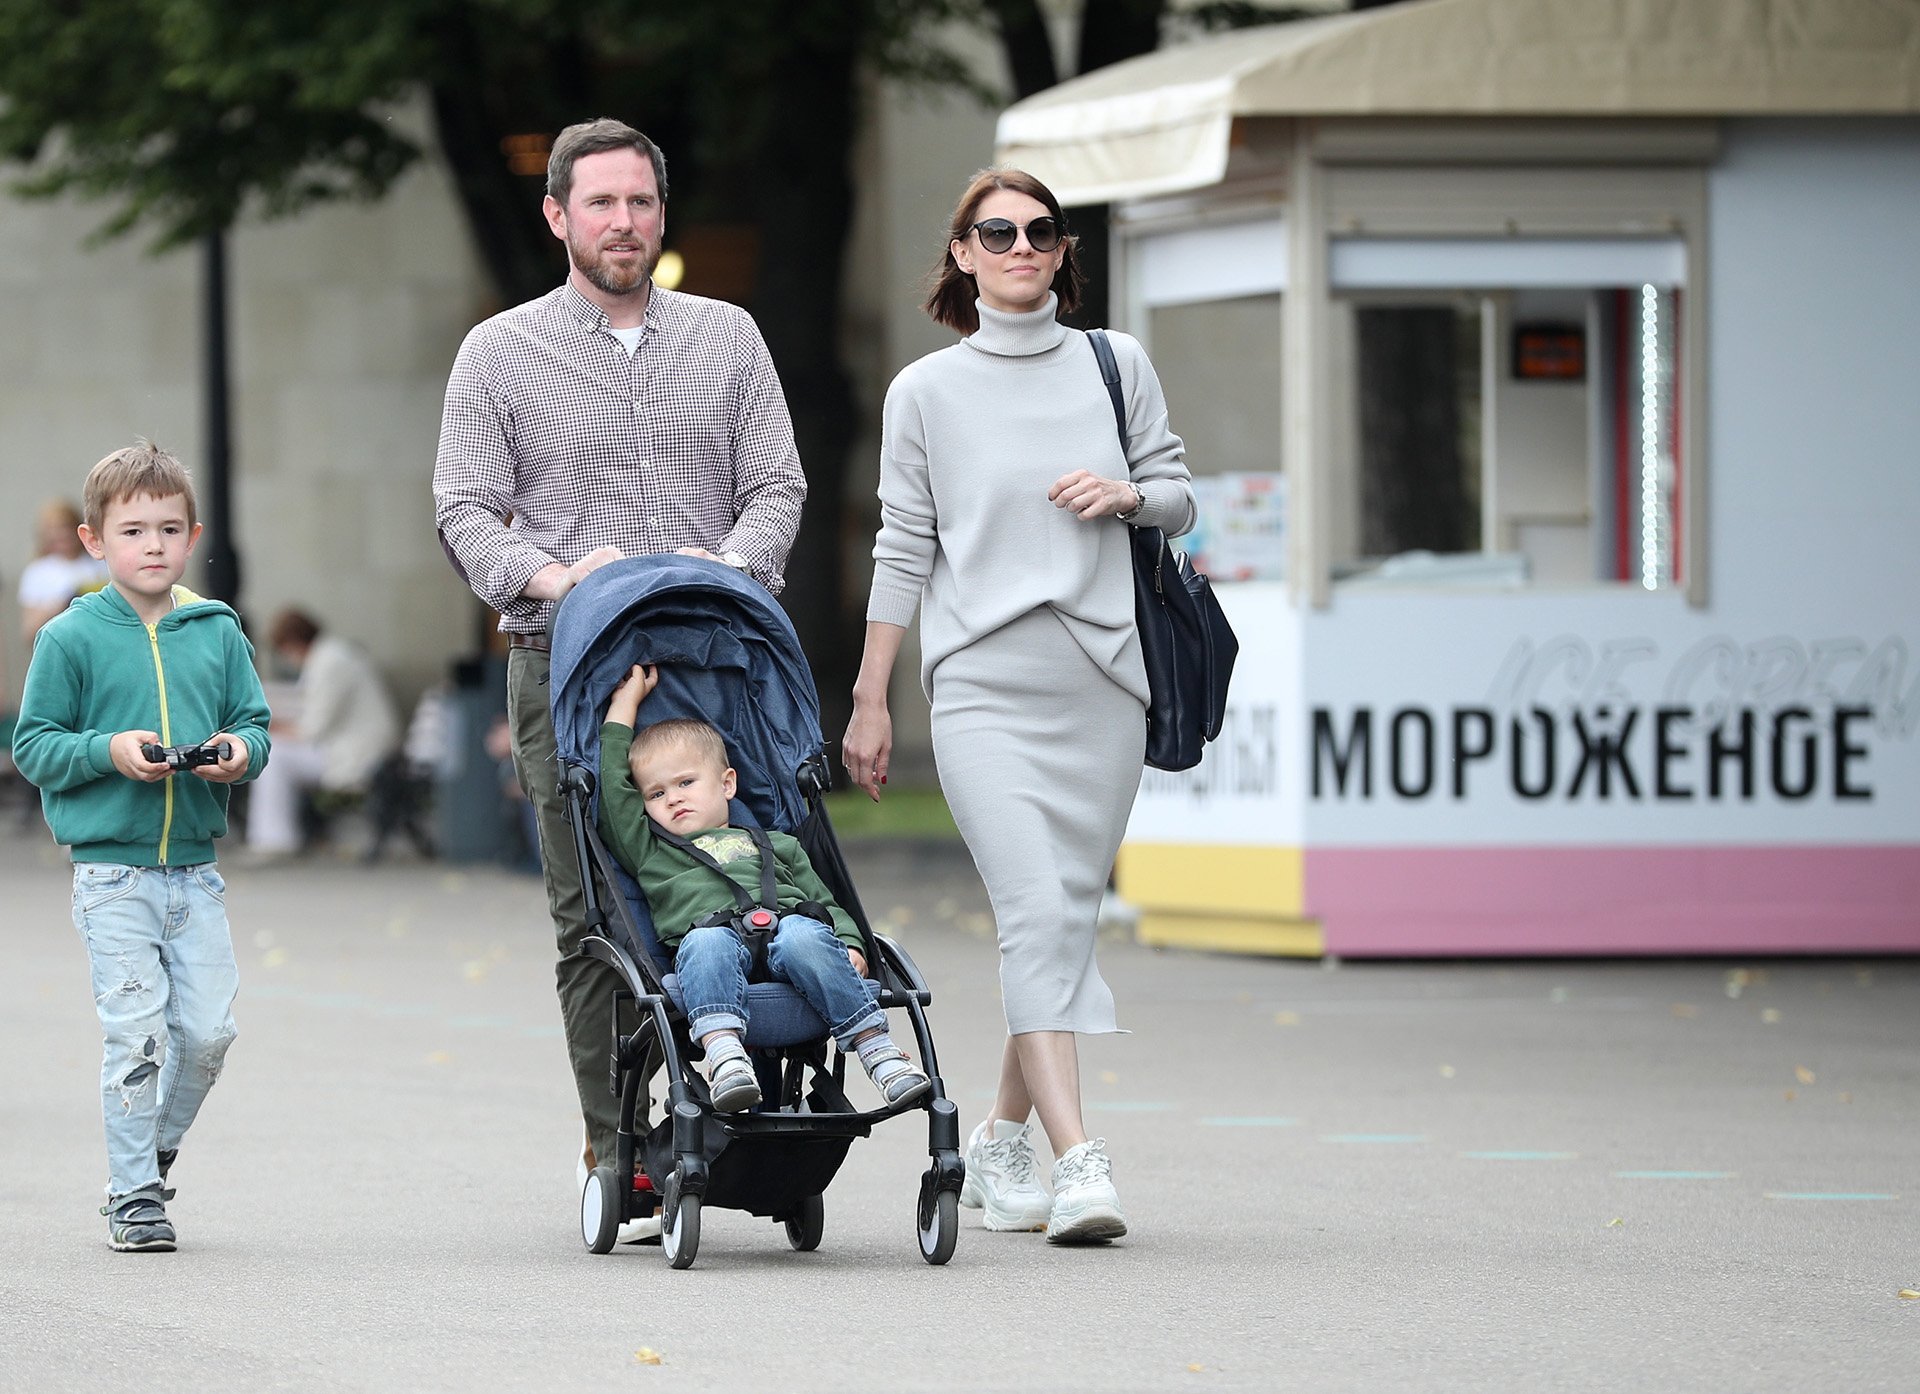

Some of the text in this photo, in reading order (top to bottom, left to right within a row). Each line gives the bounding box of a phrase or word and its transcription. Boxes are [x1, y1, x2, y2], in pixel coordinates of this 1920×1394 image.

[1482, 633, 1920, 740] ICE CREA
[1311, 706, 1874, 800] МОРОЖЕНОЕ
